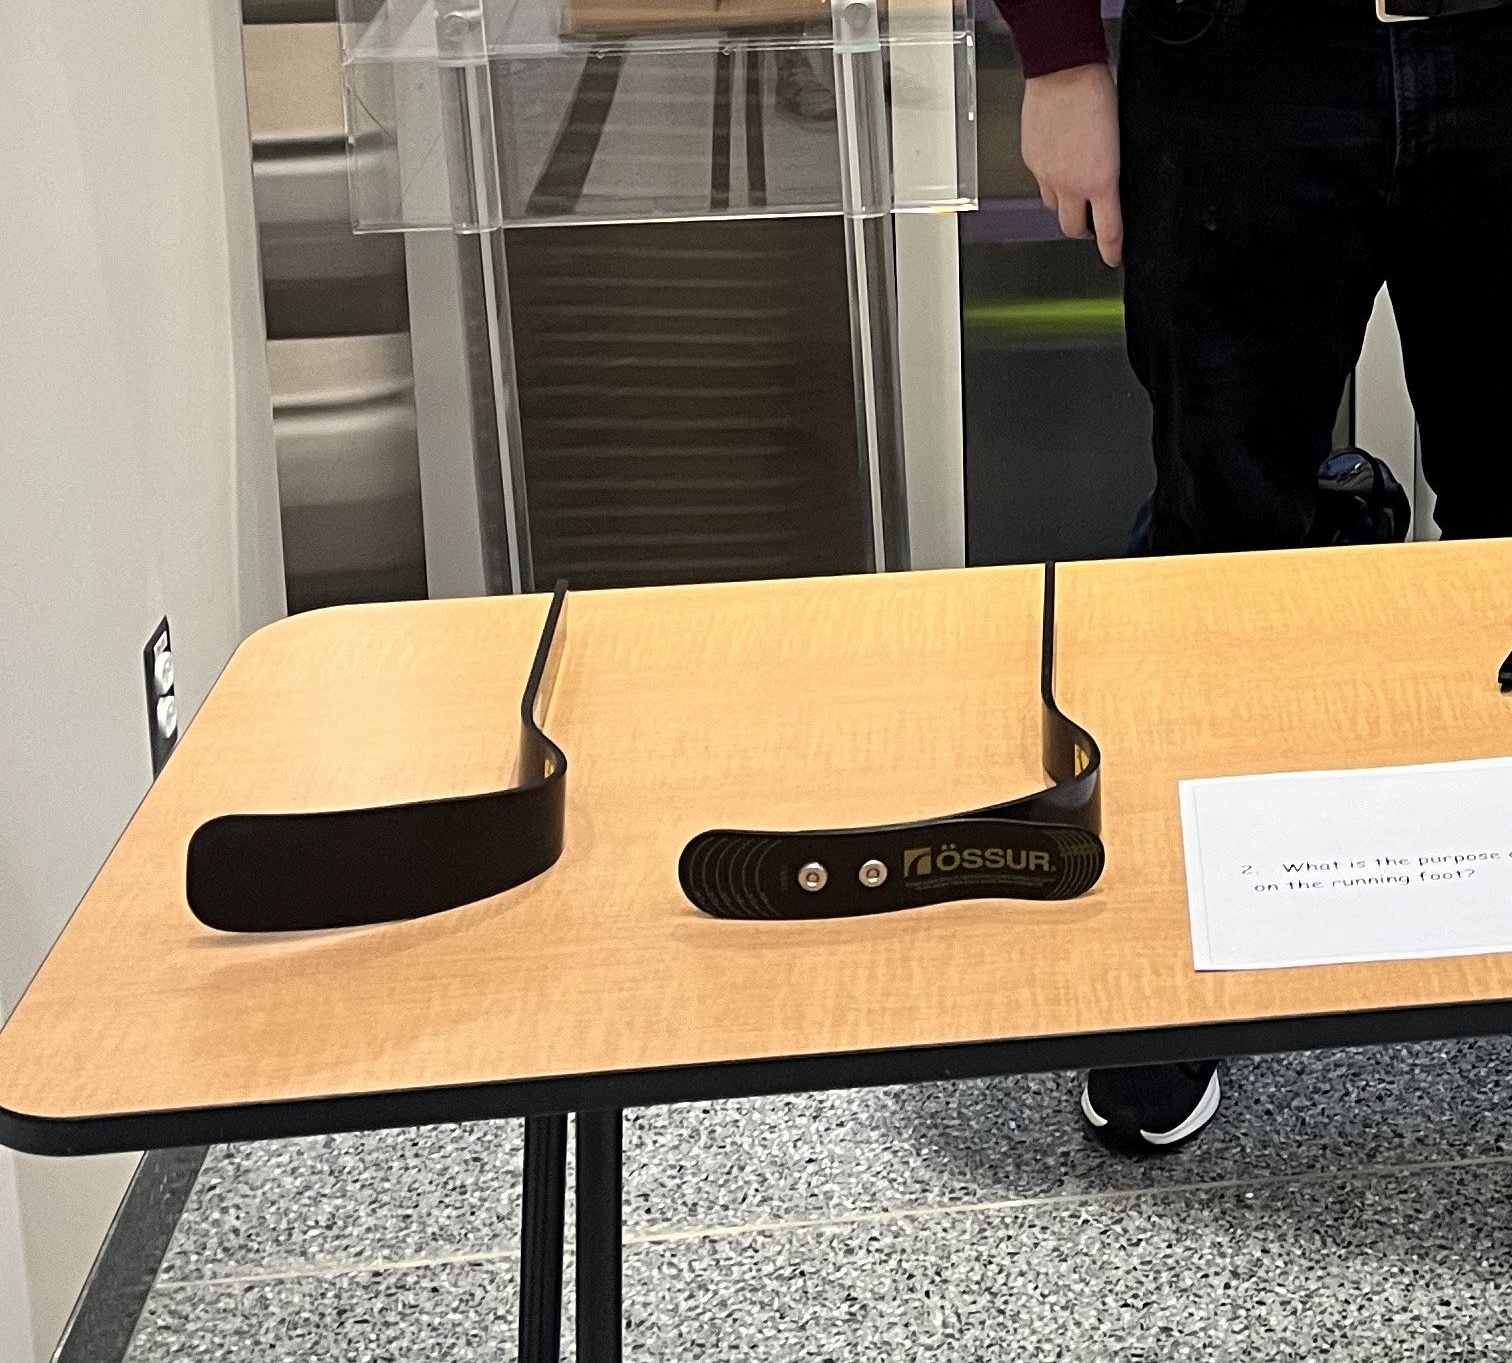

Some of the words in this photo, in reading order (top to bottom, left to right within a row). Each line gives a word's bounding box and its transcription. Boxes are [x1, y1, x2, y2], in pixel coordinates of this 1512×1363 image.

[935, 843, 1050, 871] ÖSSUR
[1241, 865, 1259, 875] 2.
[1283, 861, 1340, 872] What
[1351, 860, 1366, 868] is
[1376, 857, 1410, 866] the
[1418, 852, 1502, 866] purpose
[1254, 883, 1278, 892] on
[1289, 880, 1324, 890] the
[1332, 873, 1410, 887] running
[1419, 869, 1476, 881] foot?
